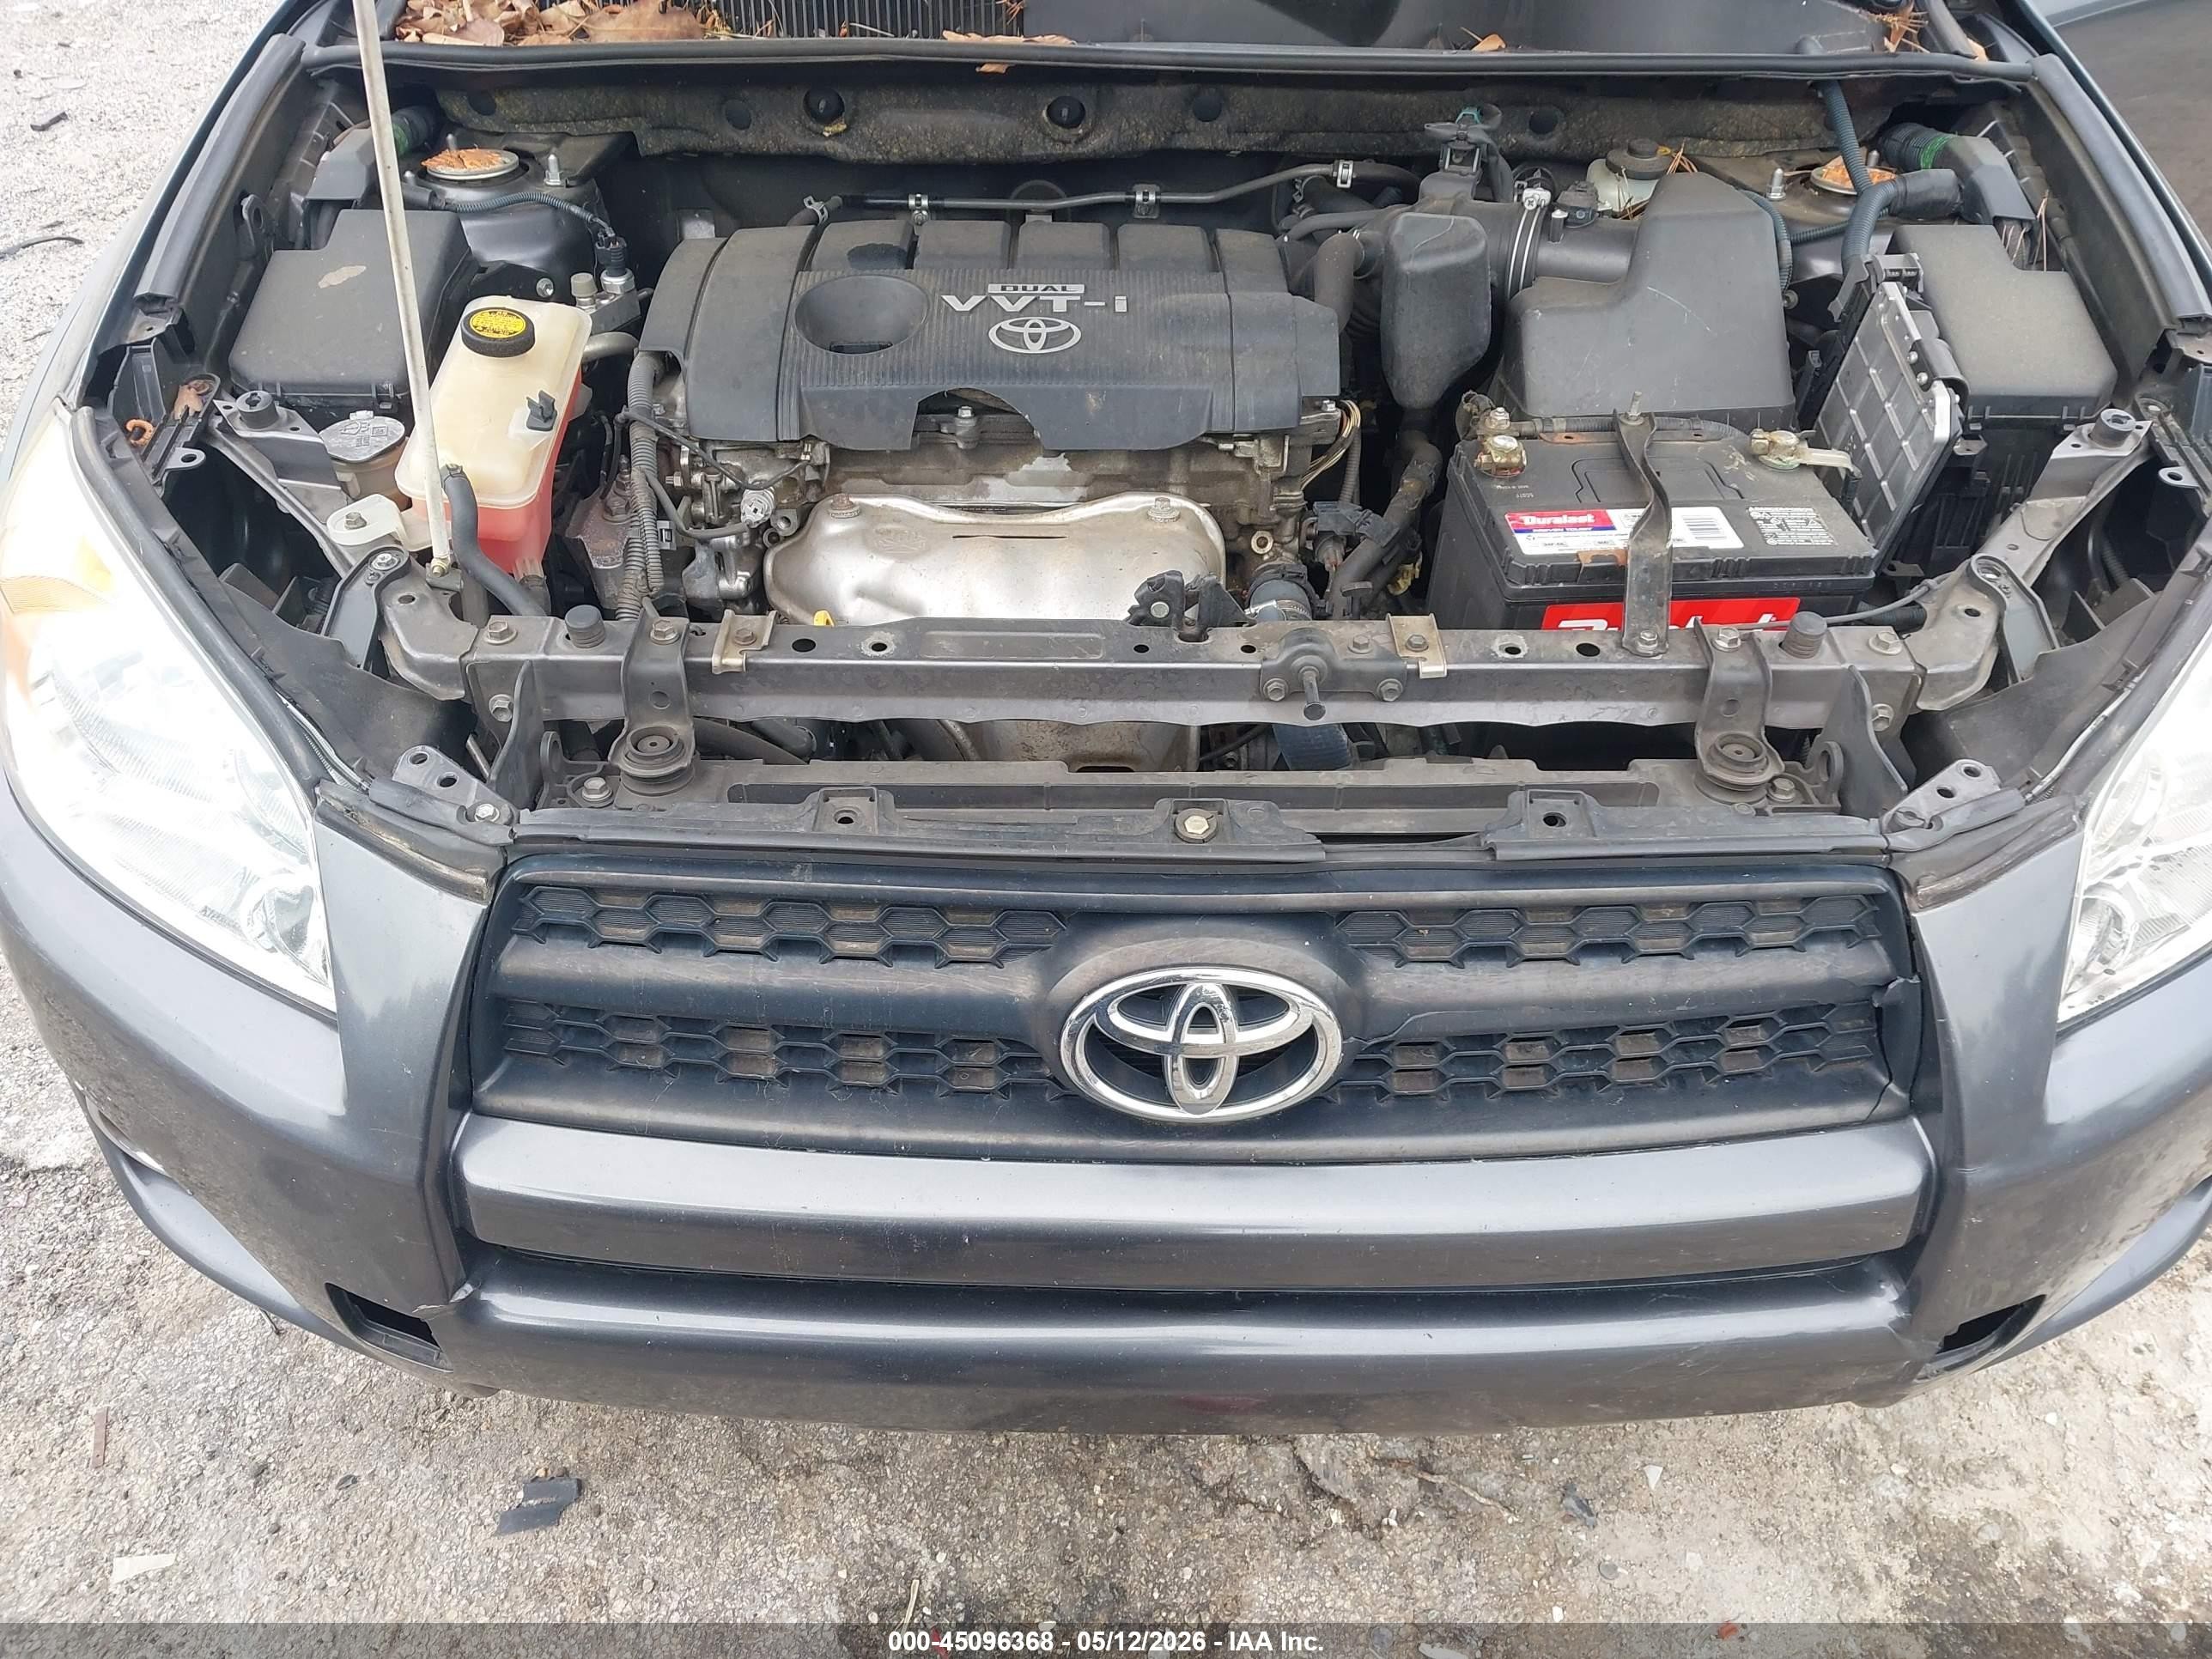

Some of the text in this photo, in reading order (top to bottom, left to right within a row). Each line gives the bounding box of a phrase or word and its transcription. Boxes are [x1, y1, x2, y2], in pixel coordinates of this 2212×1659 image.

[1000, 284, 1081, 293] DUAL
[941, 295, 1127, 313] VVT-i
[1519, 514, 1595, 526] Duralast
